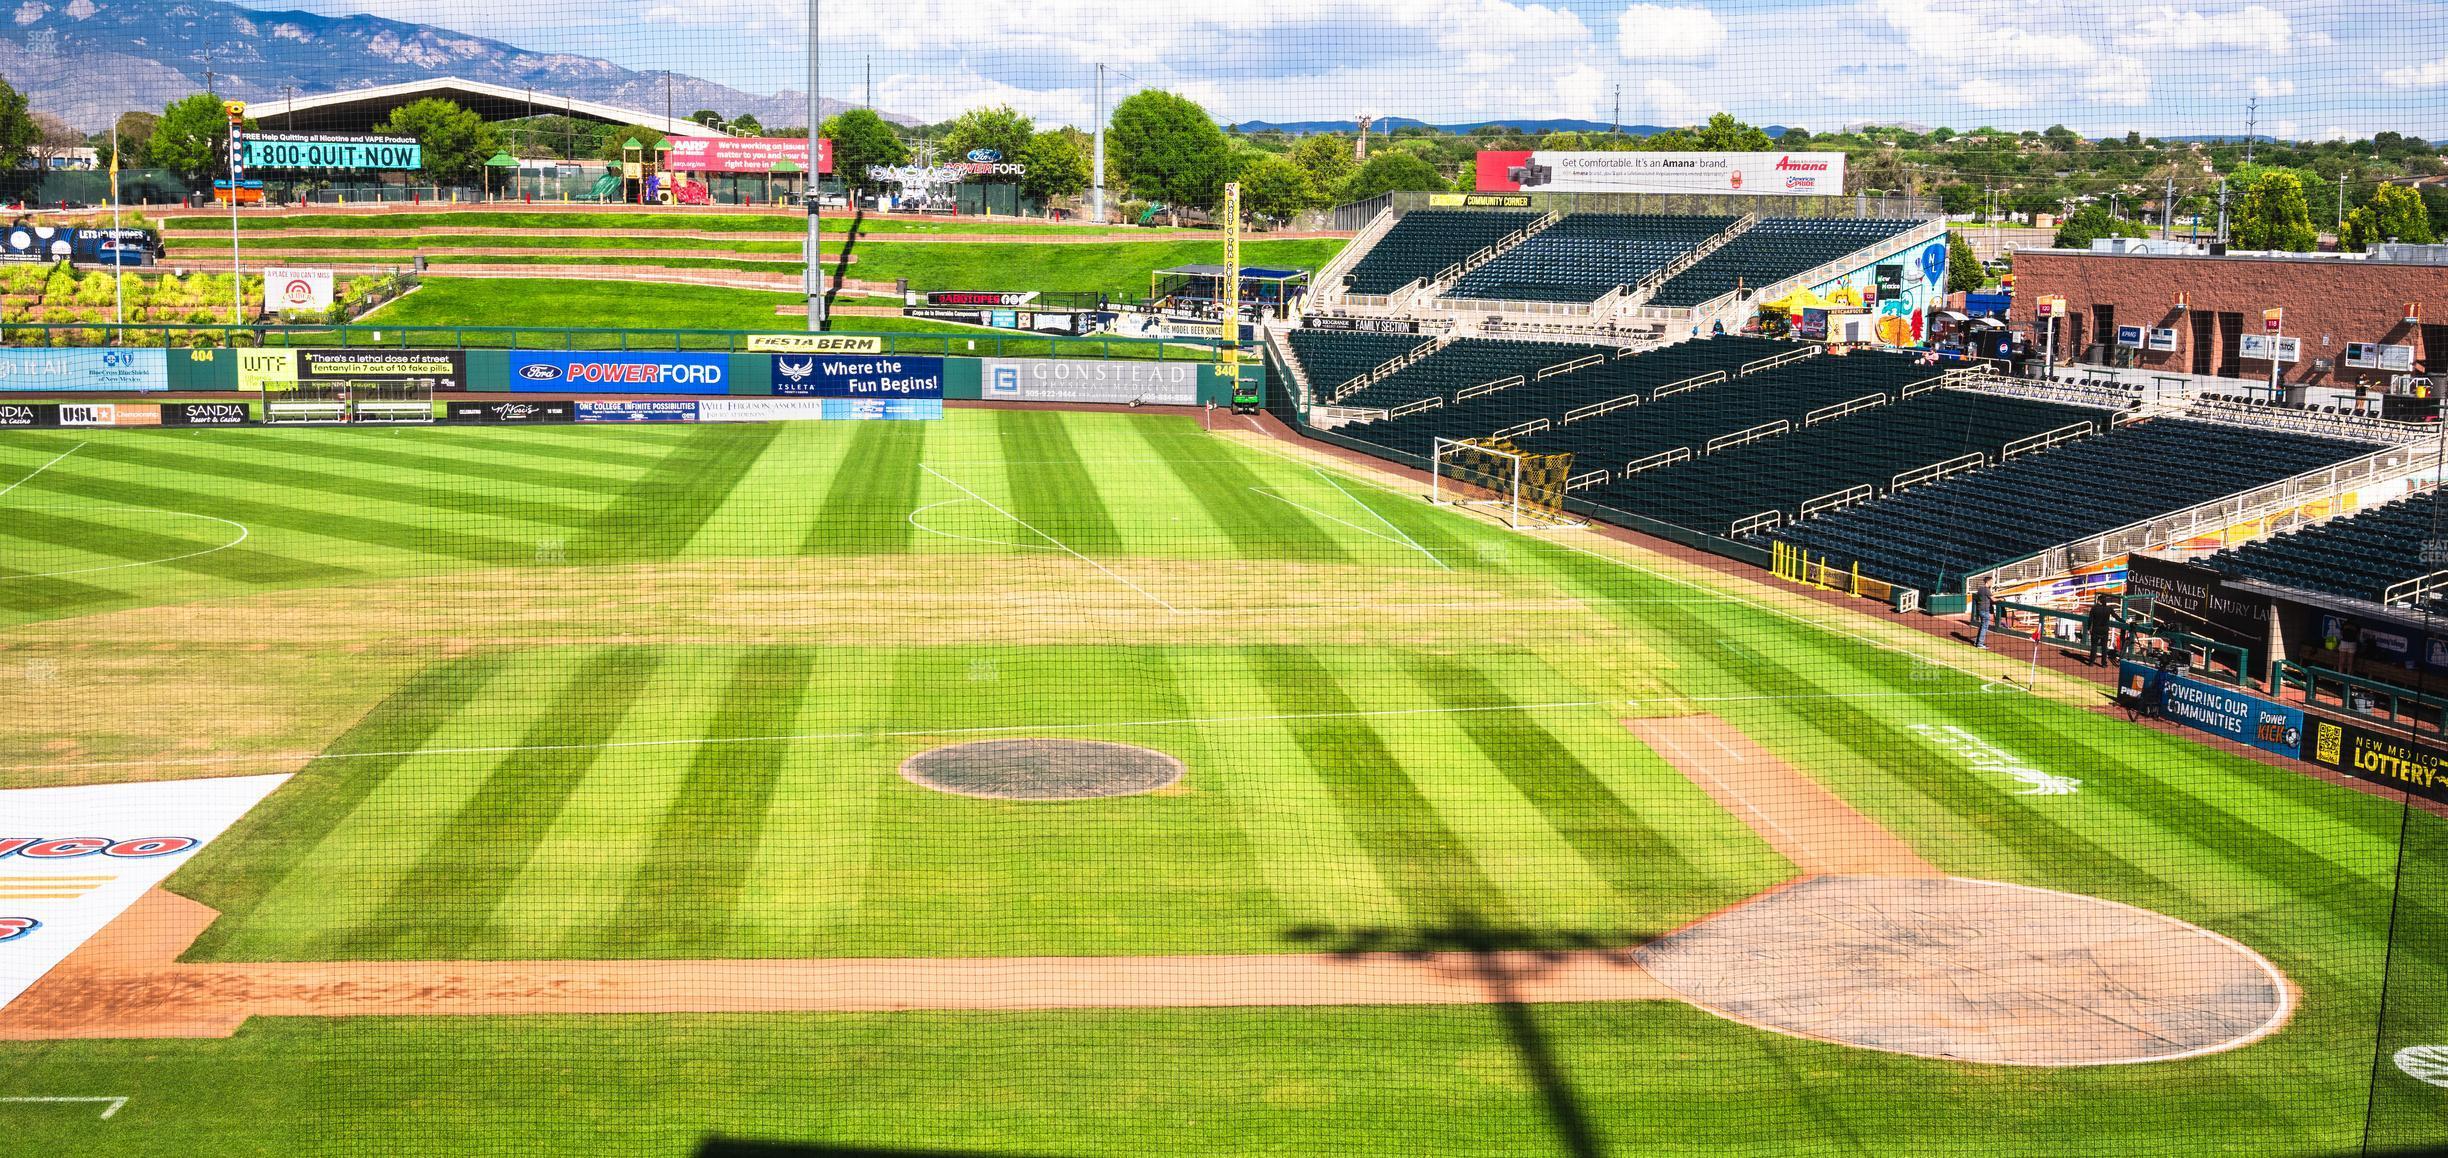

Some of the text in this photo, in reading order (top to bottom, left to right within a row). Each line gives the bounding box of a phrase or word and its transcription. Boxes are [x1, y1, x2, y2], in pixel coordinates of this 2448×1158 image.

[262, 134, 278, 142] Help
[280, 134, 308, 142] Quitting
[674, 141, 708, 150] AARP
[741, 142, 771, 151] working
[1562, 158, 1576, 167] Get
[1579, 158, 1633, 167] Comfortable.
[1635, 158, 1648, 167] It's
[1700, 159, 1728, 168] brand.
[1776, 156, 1828, 170] Amana
[1468, 196, 1503, 205] COMMUNITY
[1504, 197, 1528, 206] CORNER
[1161, 324, 1221, 335] THE MODEL BEER SINCE
[1356, 320, 1409, 332] FAMILY SECTION
[2121, 330, 2136, 338] KPMG
[754, 337, 873, 349] FIESTA BERM
[191, 350, 213, 361] 404
[357, 355, 383, 363] lethal
[385, 355, 408, 363] dose
[410, 355, 420, 363] of
[421, 355, 449, 363] street
[24, 361, 36, 374] It
[244, 356, 287, 372] WTF
[314, 364, 350, 373] fentanyl
[386, 364, 396, 372] of
[408, 364, 428, 372] fake
[430, 364, 450, 373] pills.
[822, 360, 902, 376] Where the
[1215, 365, 1235, 376] 340
[526, 366, 554, 378] Ford
[566, 363, 722, 384] POWERFORD
[1033, 363, 1185, 383] GONSTEAD
[850, 376, 938, 393] Fun Begins!
[186, 405, 243, 416] SANDIA
[2127, 569, 2206, 599] GLASHEEN, VALLES
[2184, 598, 2198, 611] LLP
[2210, 595, 2250, 617] INJURY
[2164, 682, 2248, 717] POWERING OUR
[2168, 699, 2242, 733] COMMUNITIES
[2259, 711, 2287, 725] Power
[2257, 724, 2285, 743] KICK
[2355, 736, 2383, 751] NEW
[2354, 748, 2437, 788] LOTTERY
